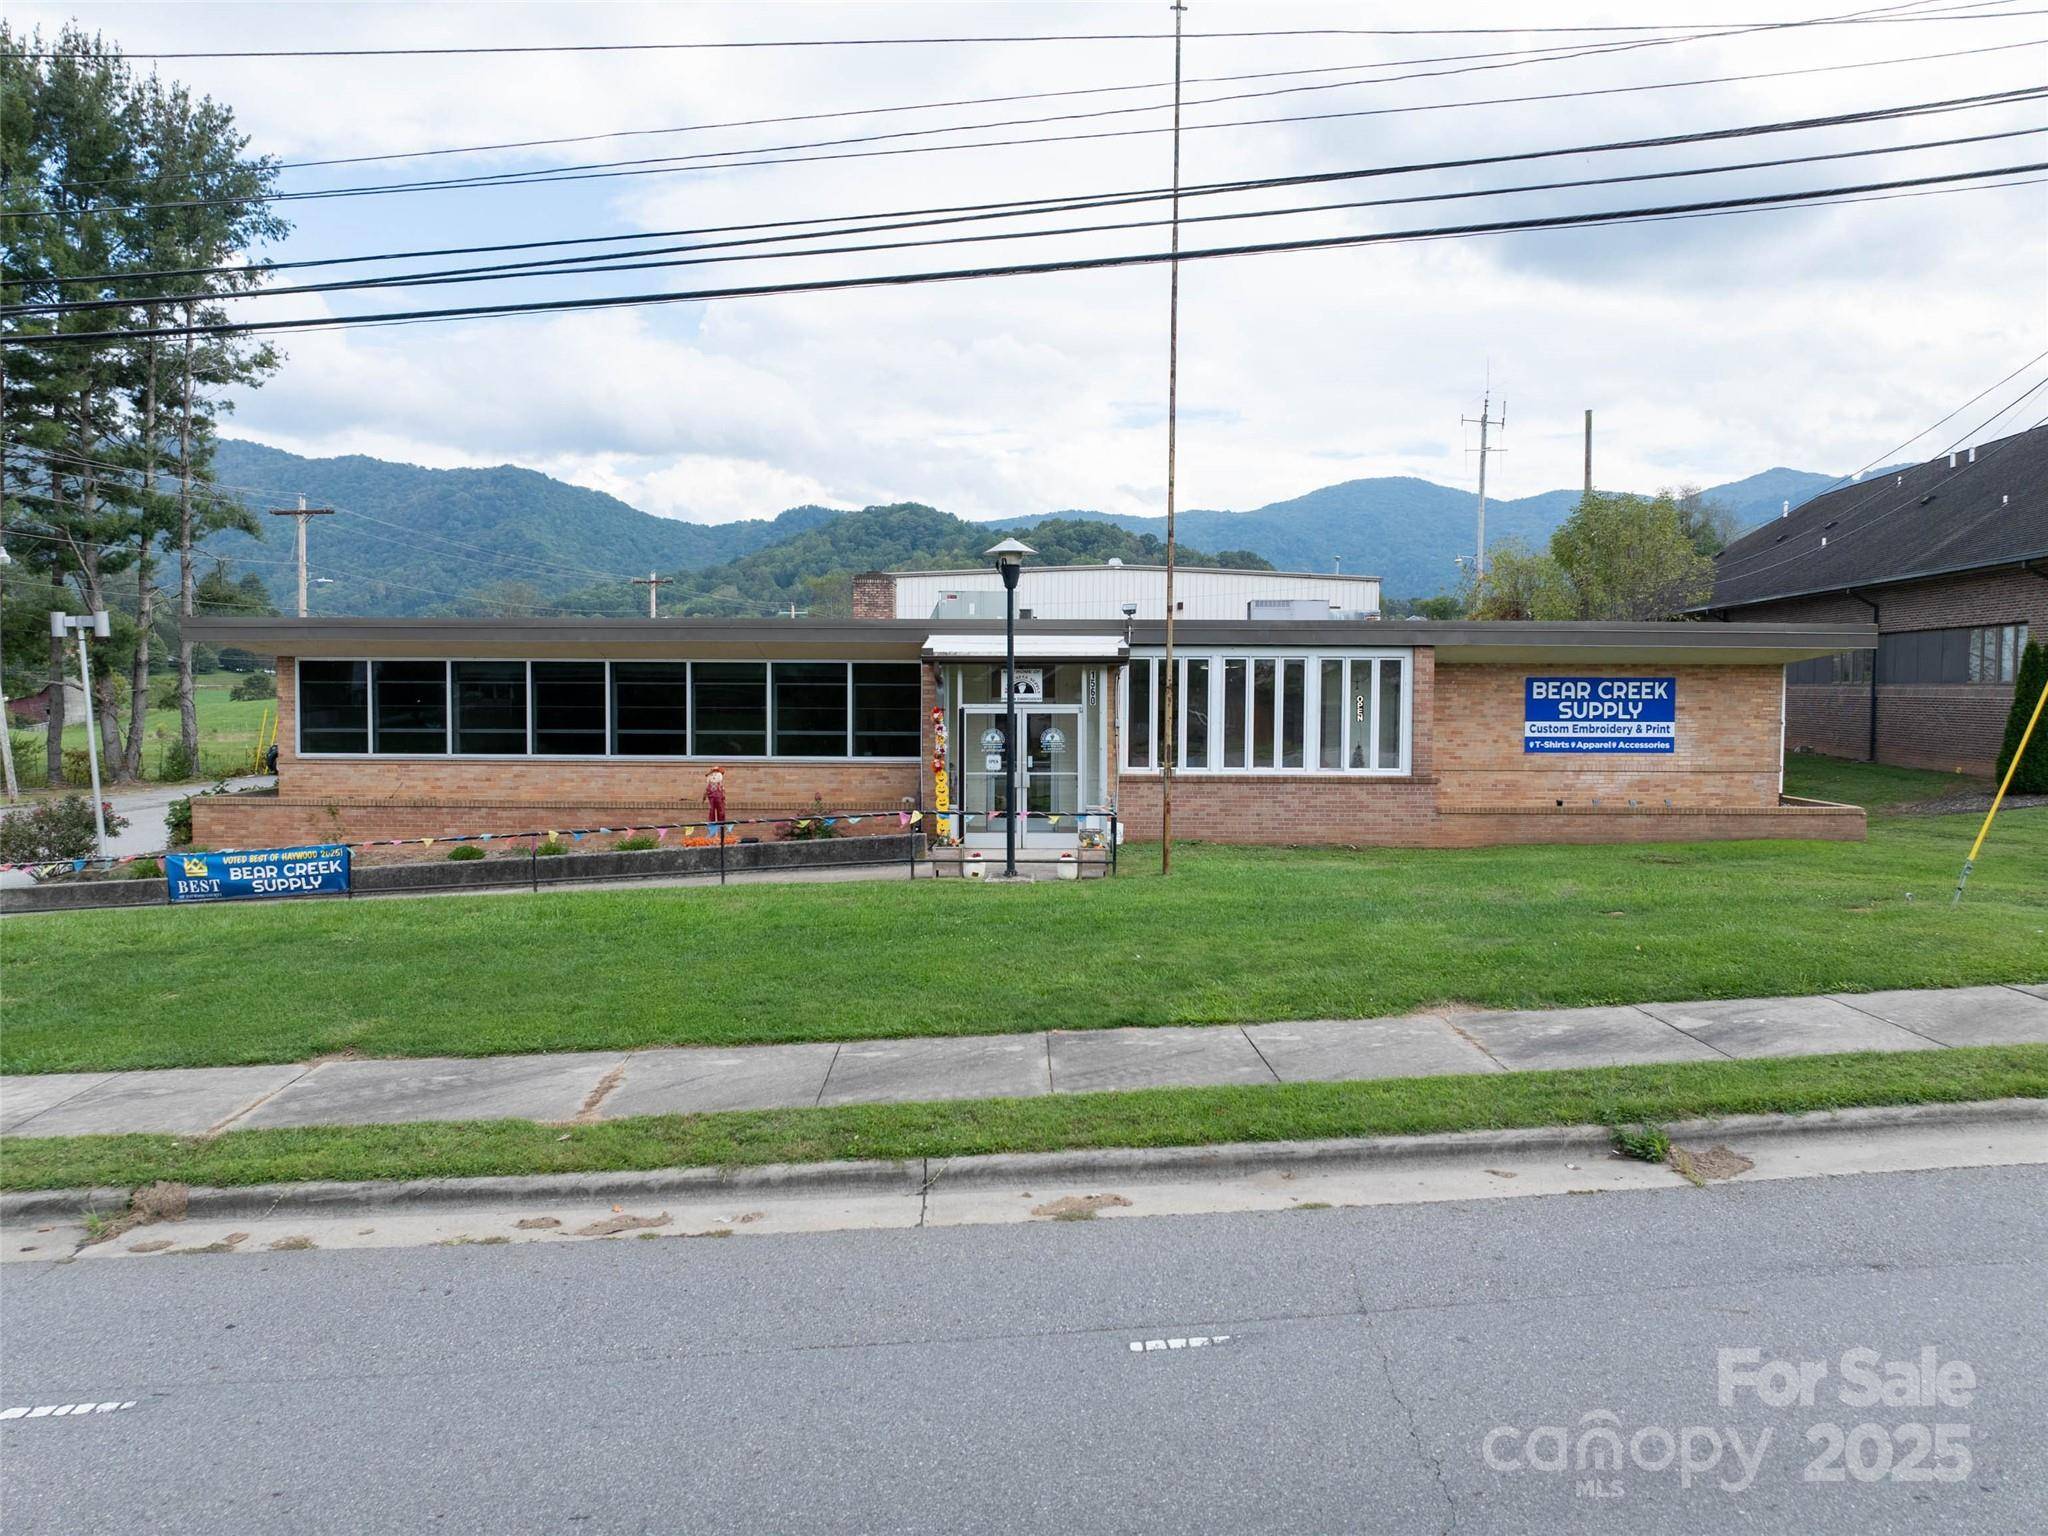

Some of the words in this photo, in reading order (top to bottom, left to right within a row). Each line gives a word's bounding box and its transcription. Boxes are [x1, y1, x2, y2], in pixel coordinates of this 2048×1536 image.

[1532, 681, 1591, 699] BEAR
[1597, 681, 1668, 699] CREEK
[1558, 701, 1643, 719] SUPPLY
[1529, 724, 1569, 734] Custom
[1572, 723, 1633, 735] Embroidery
[1636, 724, 1643, 734] &
[1645, 723, 1671, 734] Print
[1535, 741, 1570, 749] T-Shirts
[1576, 741, 1611, 751] Apparel
[1618, 741, 1670, 749] Accessories
[223, 855, 248, 865] VOTED
[249, 854, 267, 864] BEST
[269, 853, 279, 862] OF
[282, 850, 318, 861] HAYWOOD
[229, 865, 278, 880] BEAR
[283, 859, 343, 877] CREEK
[177, 879, 221, 894] BEST
[252, 875, 322, 893] SUPPLY
